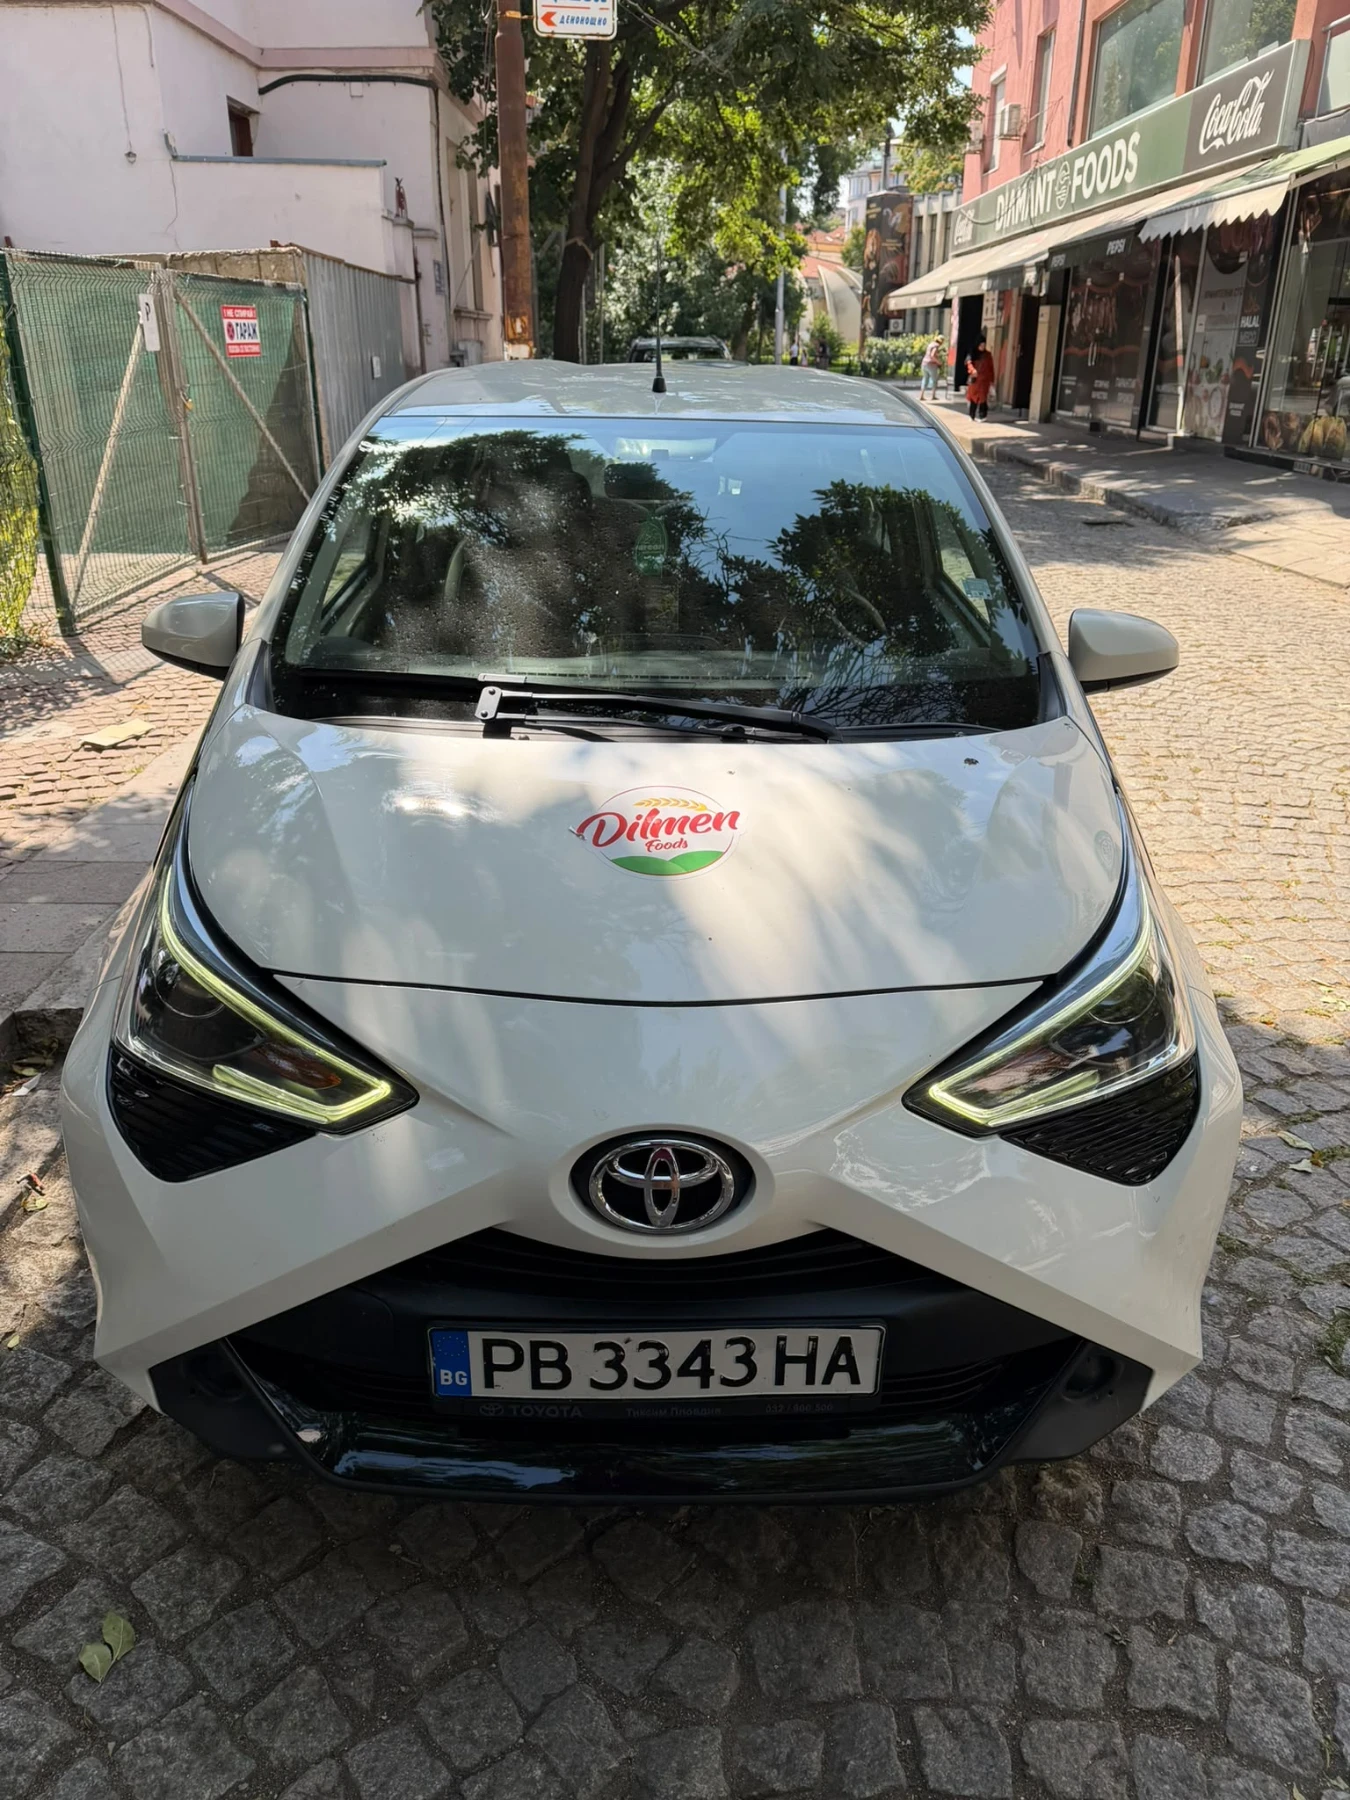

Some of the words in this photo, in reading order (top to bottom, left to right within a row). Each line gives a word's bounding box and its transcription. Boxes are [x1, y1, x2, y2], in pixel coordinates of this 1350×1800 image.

[559, 14, 607, 26] ДЕНОНОЩНО
[995, 169, 1057, 231] DIAMANT
[1071, 131, 1141, 203] FOODS
[1106, 239, 1126, 256] PEPSI
[1240, 315, 1260, 328] HALAL
[235, 322, 259, 340] ГАРАЖ
[576, 808, 741, 847] Dilmen
[645, 838, 688, 852] Foods
[440, 1368, 468, 1386] BG
[481, 1337, 573, 1390] PB
[589, 1335, 758, 1391] 3343
[774, 1335, 861, 1387] HA
[508, 1404, 583, 1418] TOYOTA
